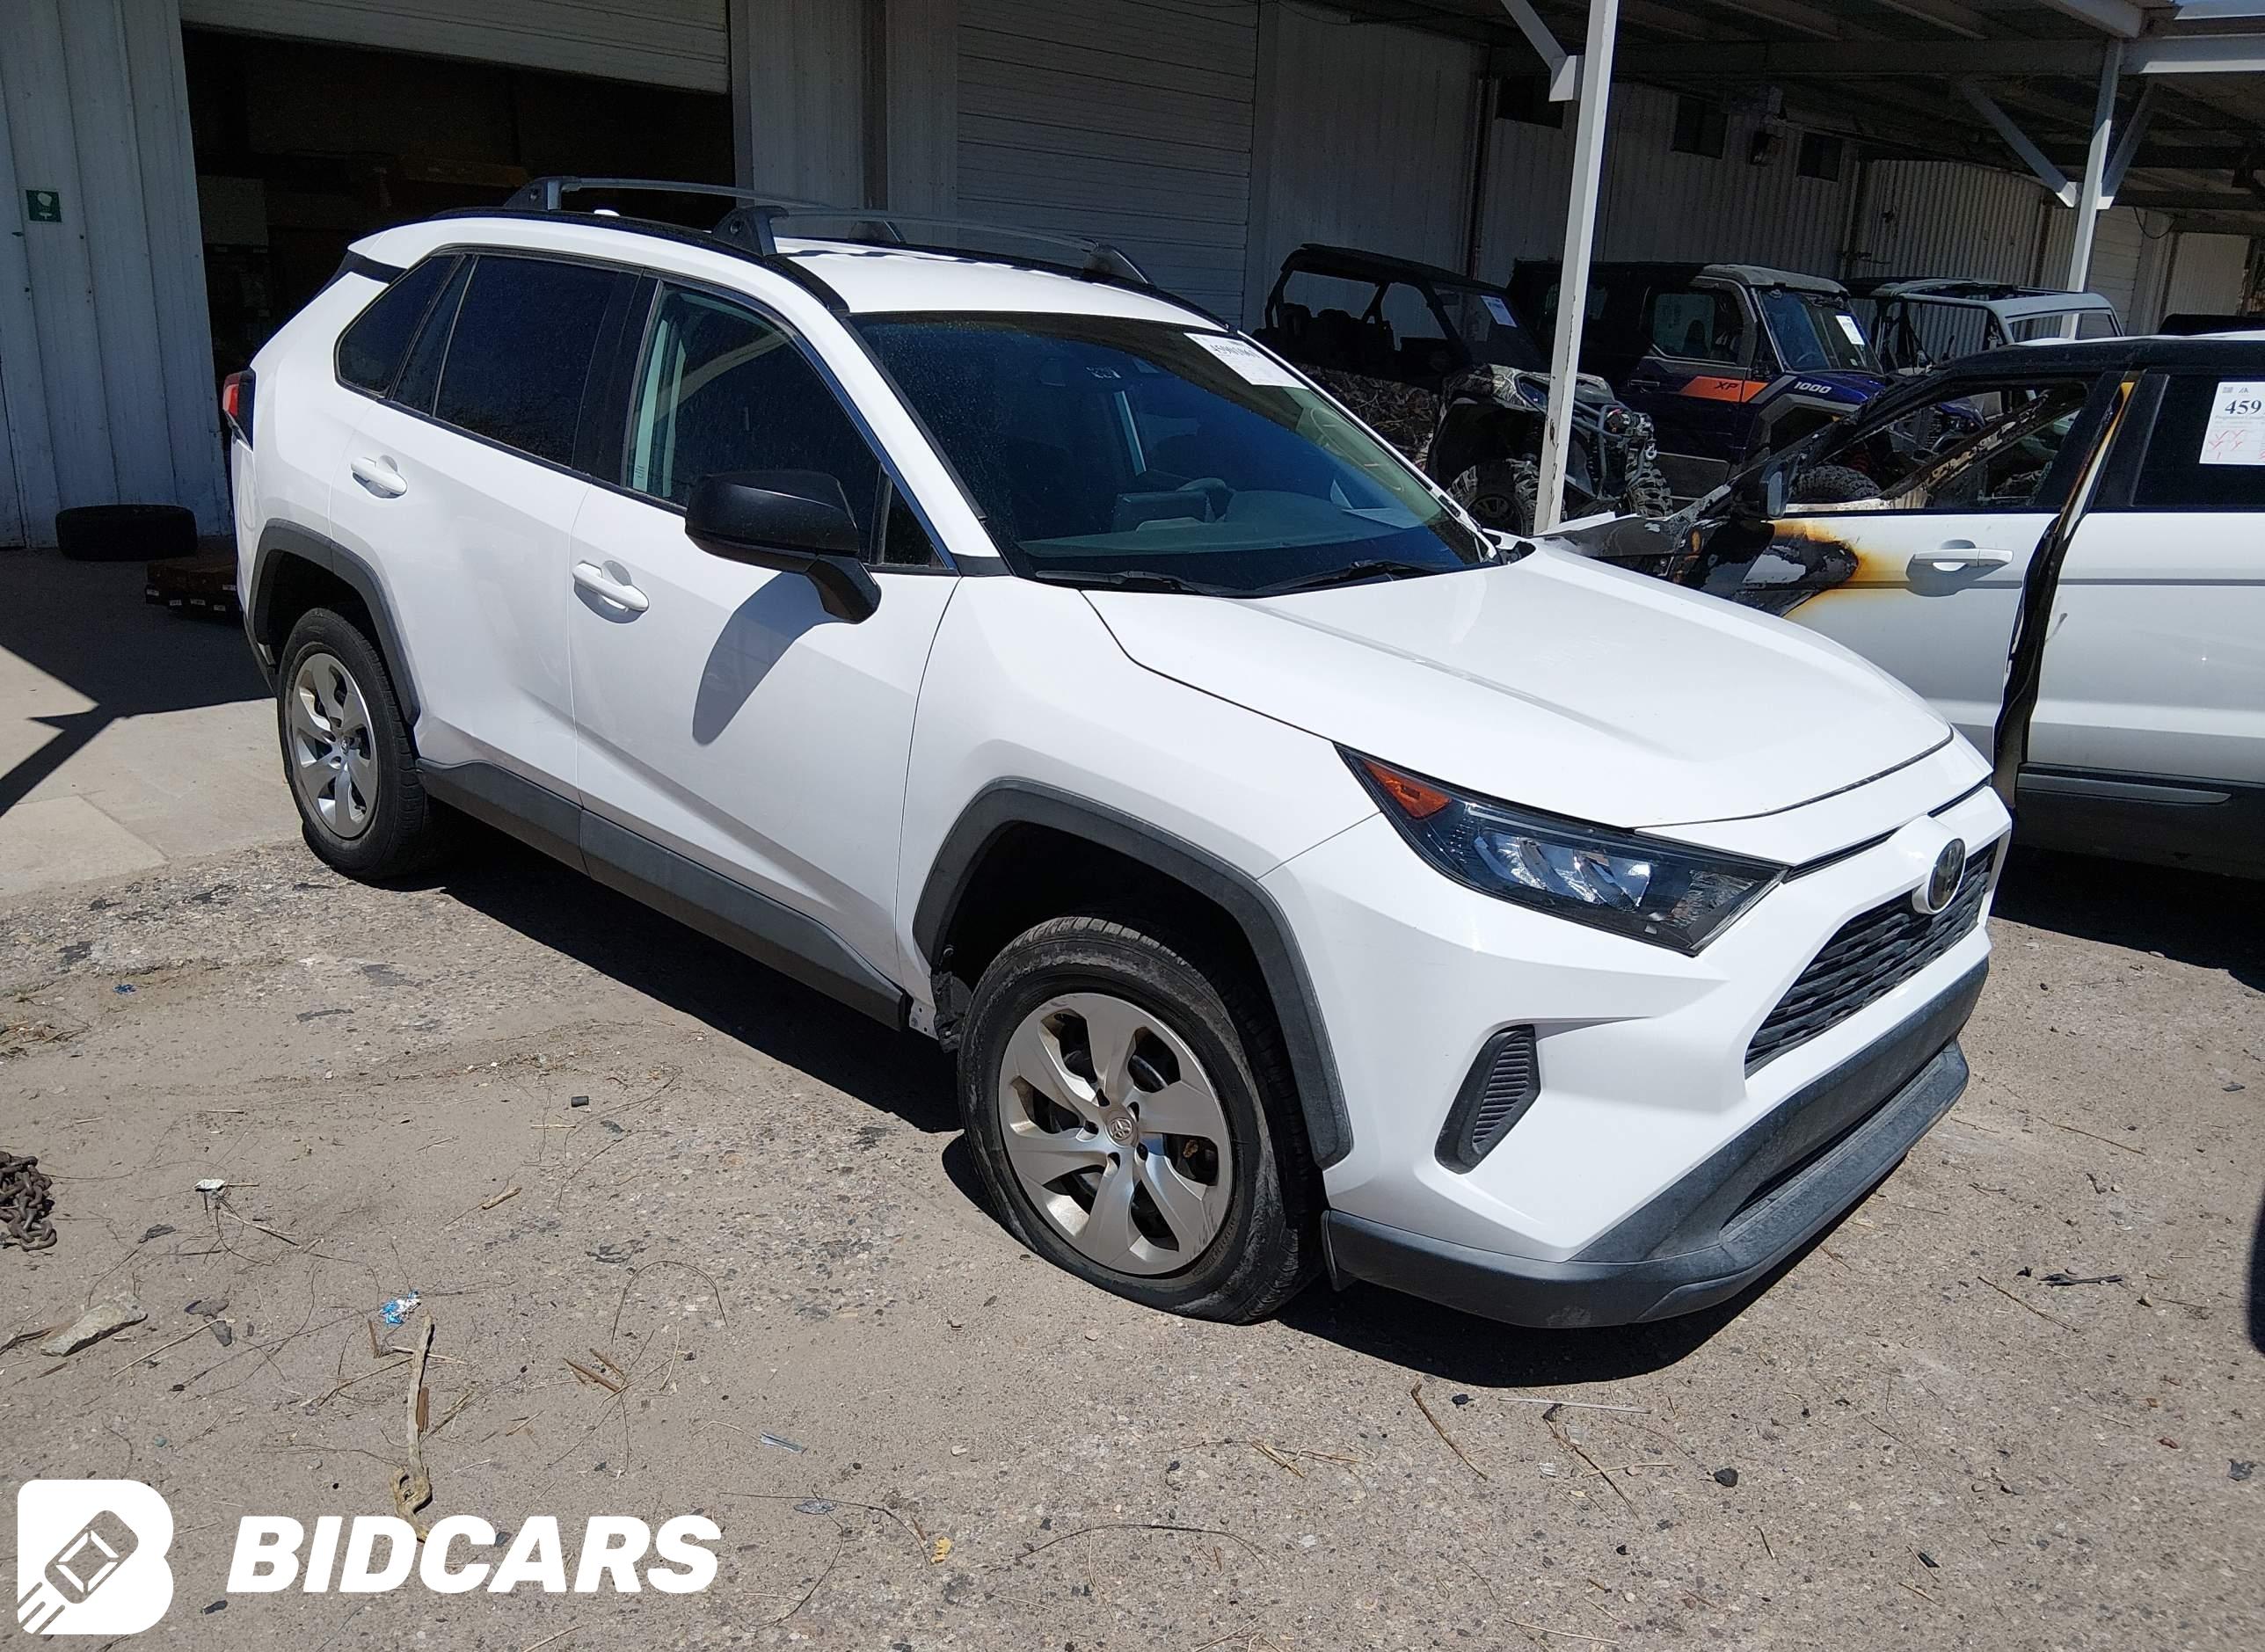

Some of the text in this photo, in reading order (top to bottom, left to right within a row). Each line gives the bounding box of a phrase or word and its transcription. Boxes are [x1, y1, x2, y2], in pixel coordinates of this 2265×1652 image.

[1715, 381, 1738, 390] XP
[1794, 381, 1832, 394] 1000
[2225, 399, 2262, 415] 459
